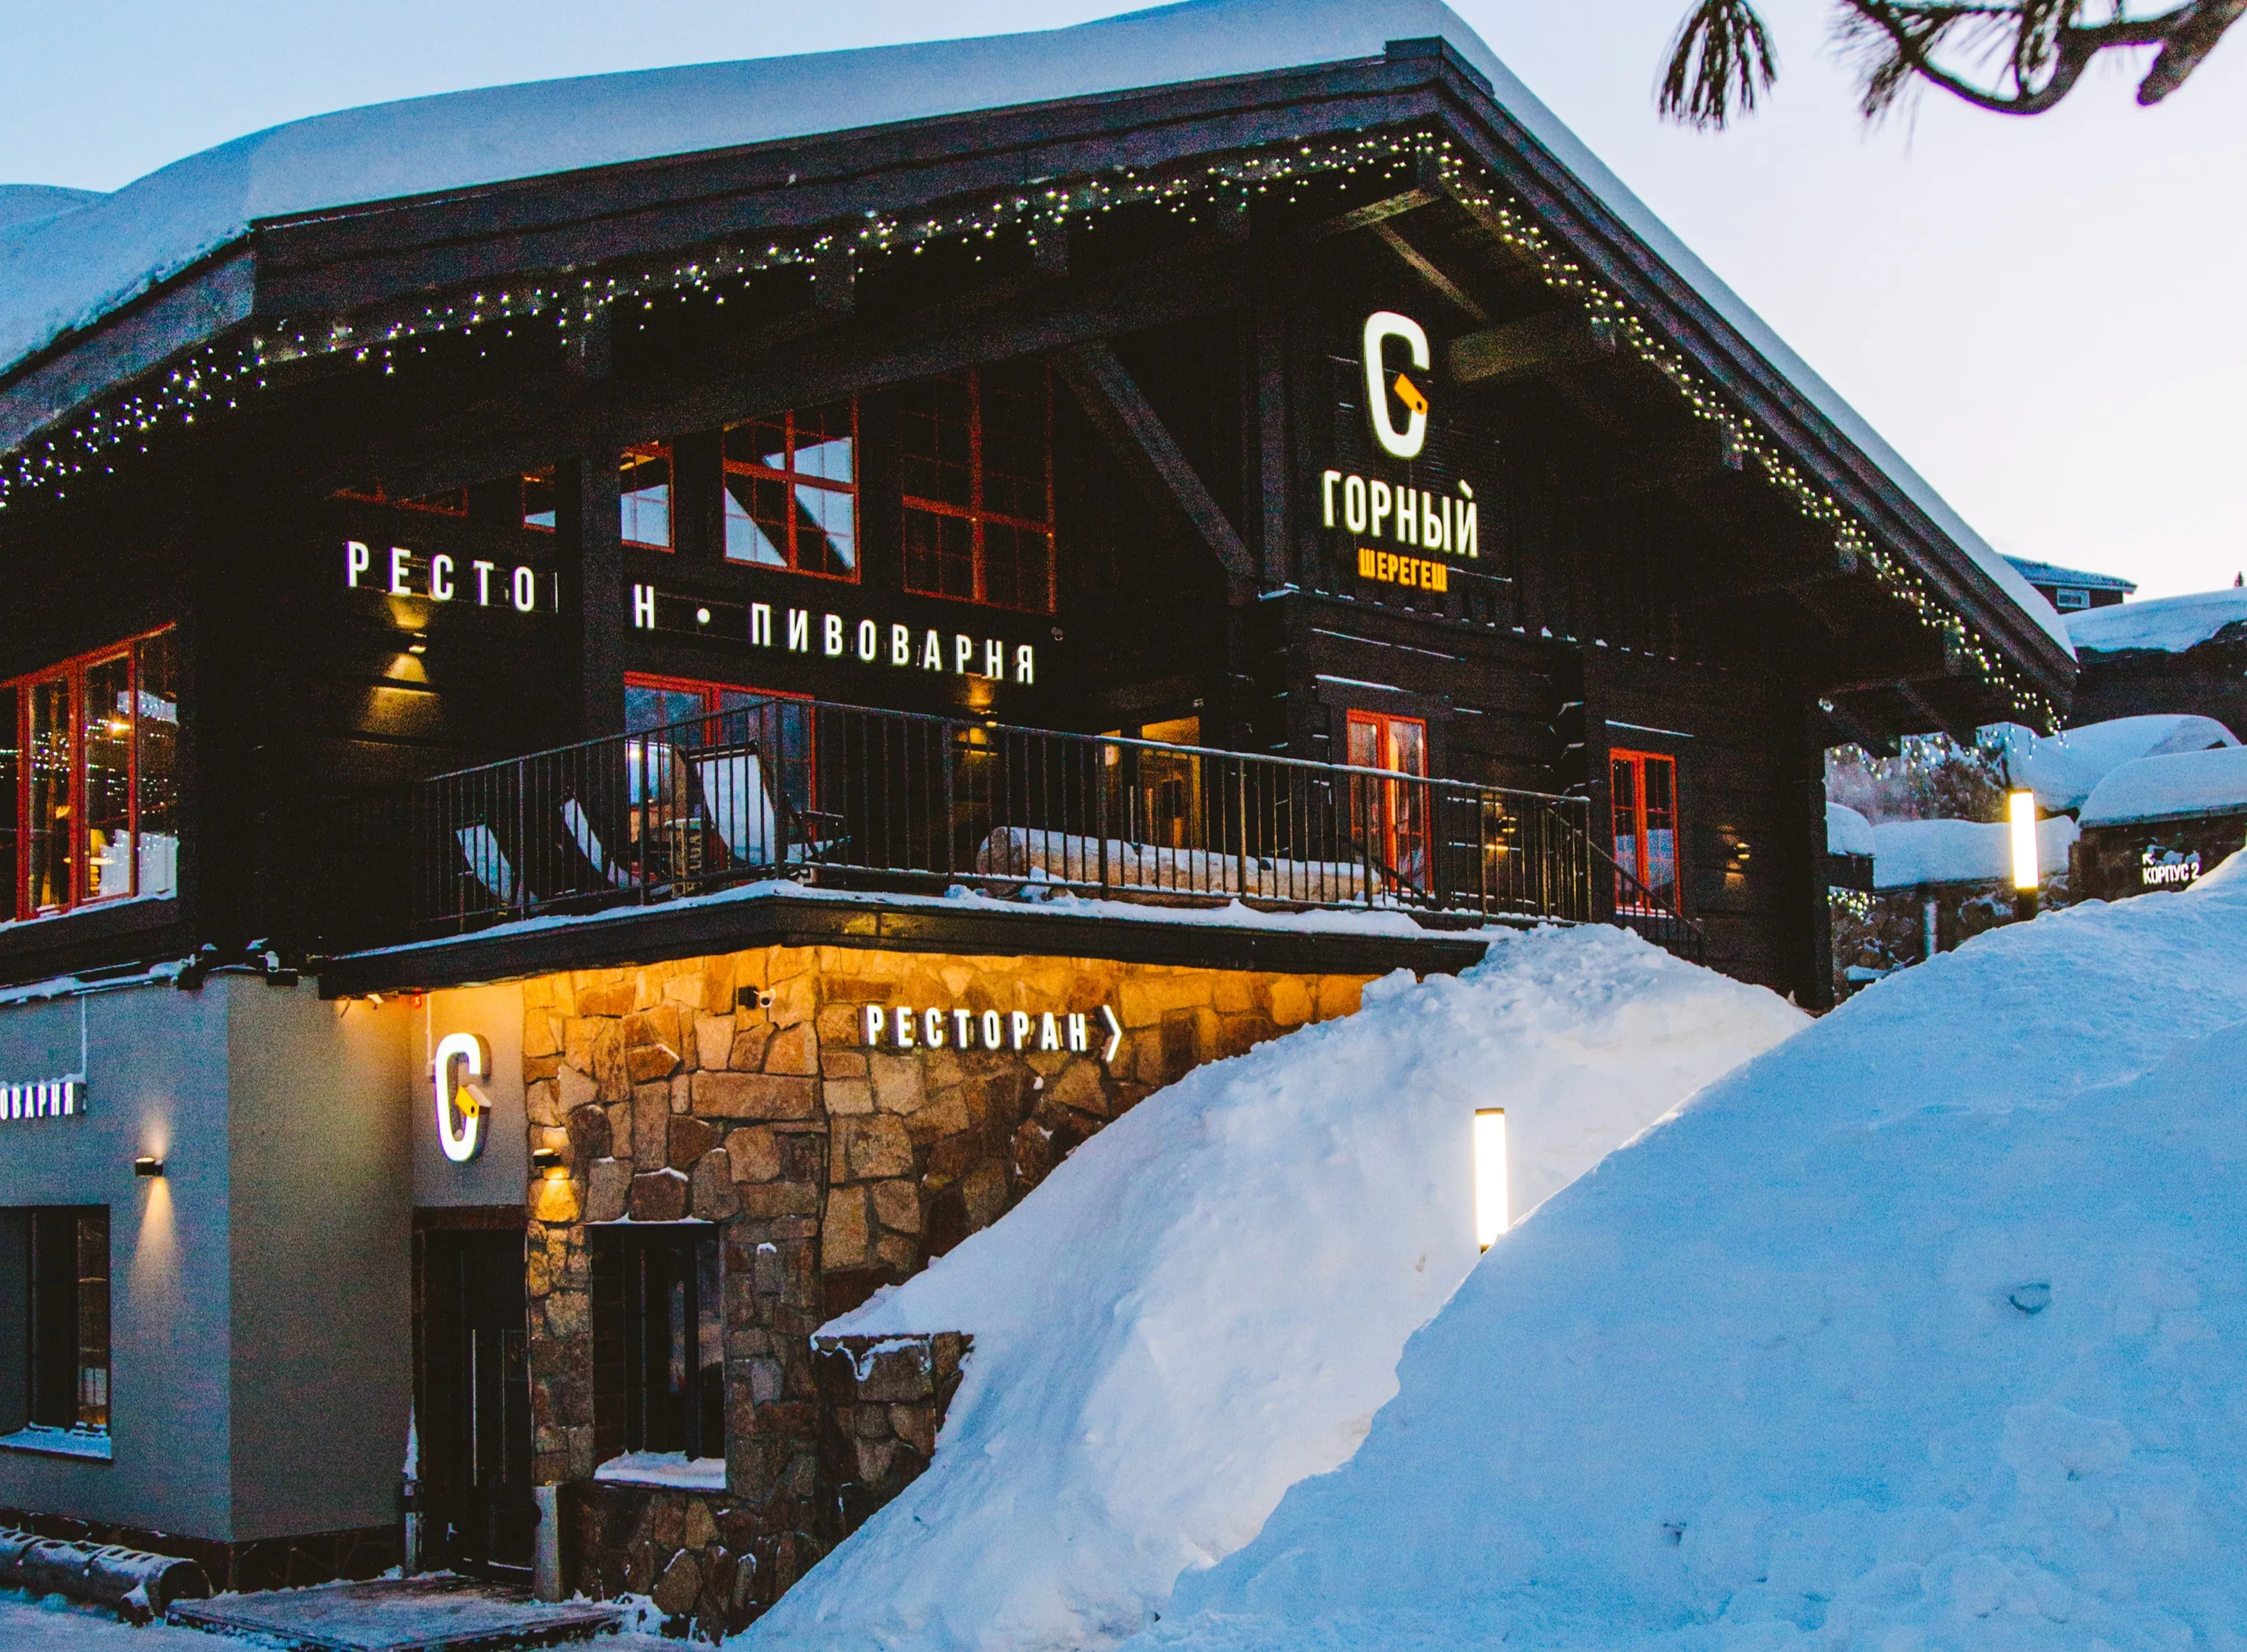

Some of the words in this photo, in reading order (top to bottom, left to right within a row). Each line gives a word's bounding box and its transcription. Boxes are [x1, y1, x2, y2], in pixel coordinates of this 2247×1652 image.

[1323, 469, 1478, 558] ГОРНЫЙ
[1359, 548, 1448, 592] ШЕРЕГЕШ
[346, 540, 655, 630] РЕСТОН
[752, 602, 1035, 685] ПИВОВАРНЯ
[2142, 864, 2189, 884] КОРПУС
[2191, 862, 2200, 880] 2
[865, 1005, 1087, 1052] РЕСТОРАН
